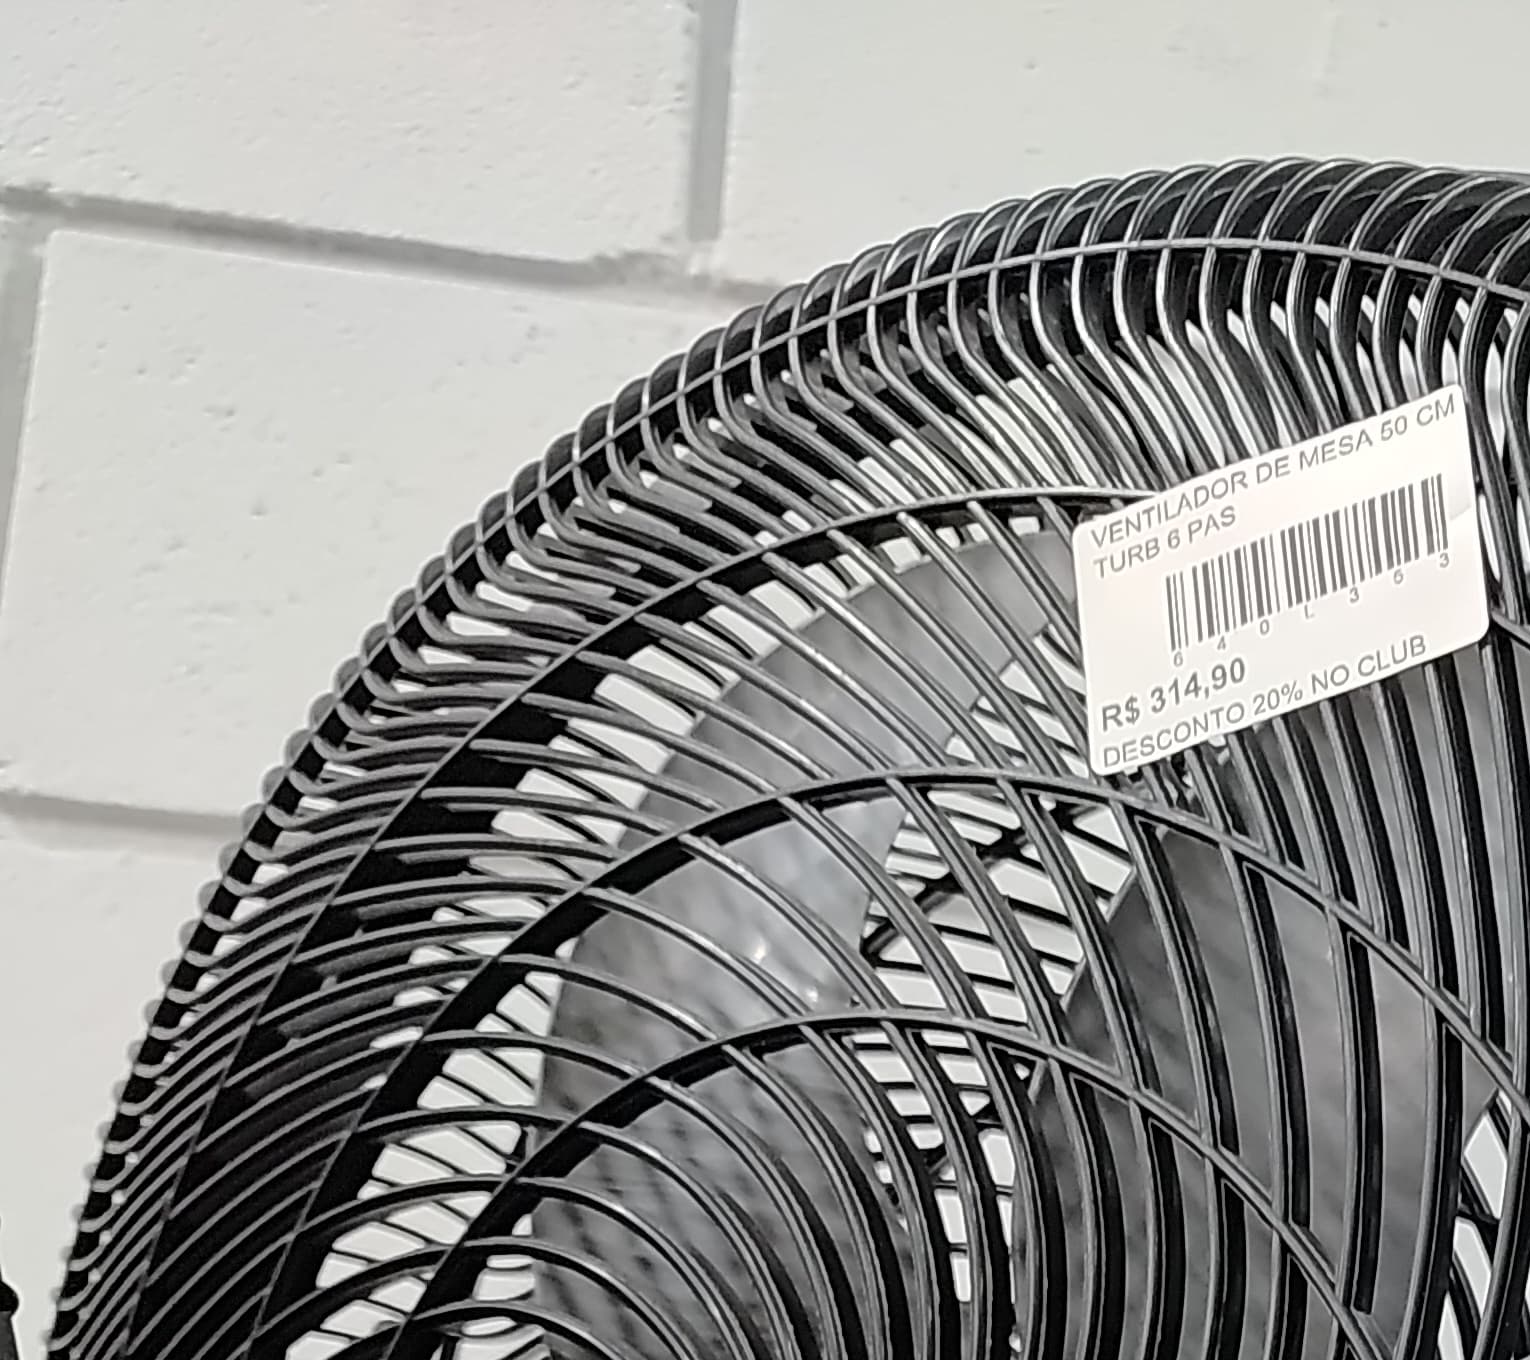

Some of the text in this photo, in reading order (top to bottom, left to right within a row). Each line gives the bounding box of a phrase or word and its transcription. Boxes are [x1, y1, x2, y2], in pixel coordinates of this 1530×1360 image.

[1091, 394, 1456, 549] VENTILADOR DE MESA 50 CM
[1093, 504, 1237, 579] TURB 6 PAS
[1101, 657, 1247, 732] R$ 314,90
[1102, 634, 1427, 768] DESCONTO 20% NO CLUB
